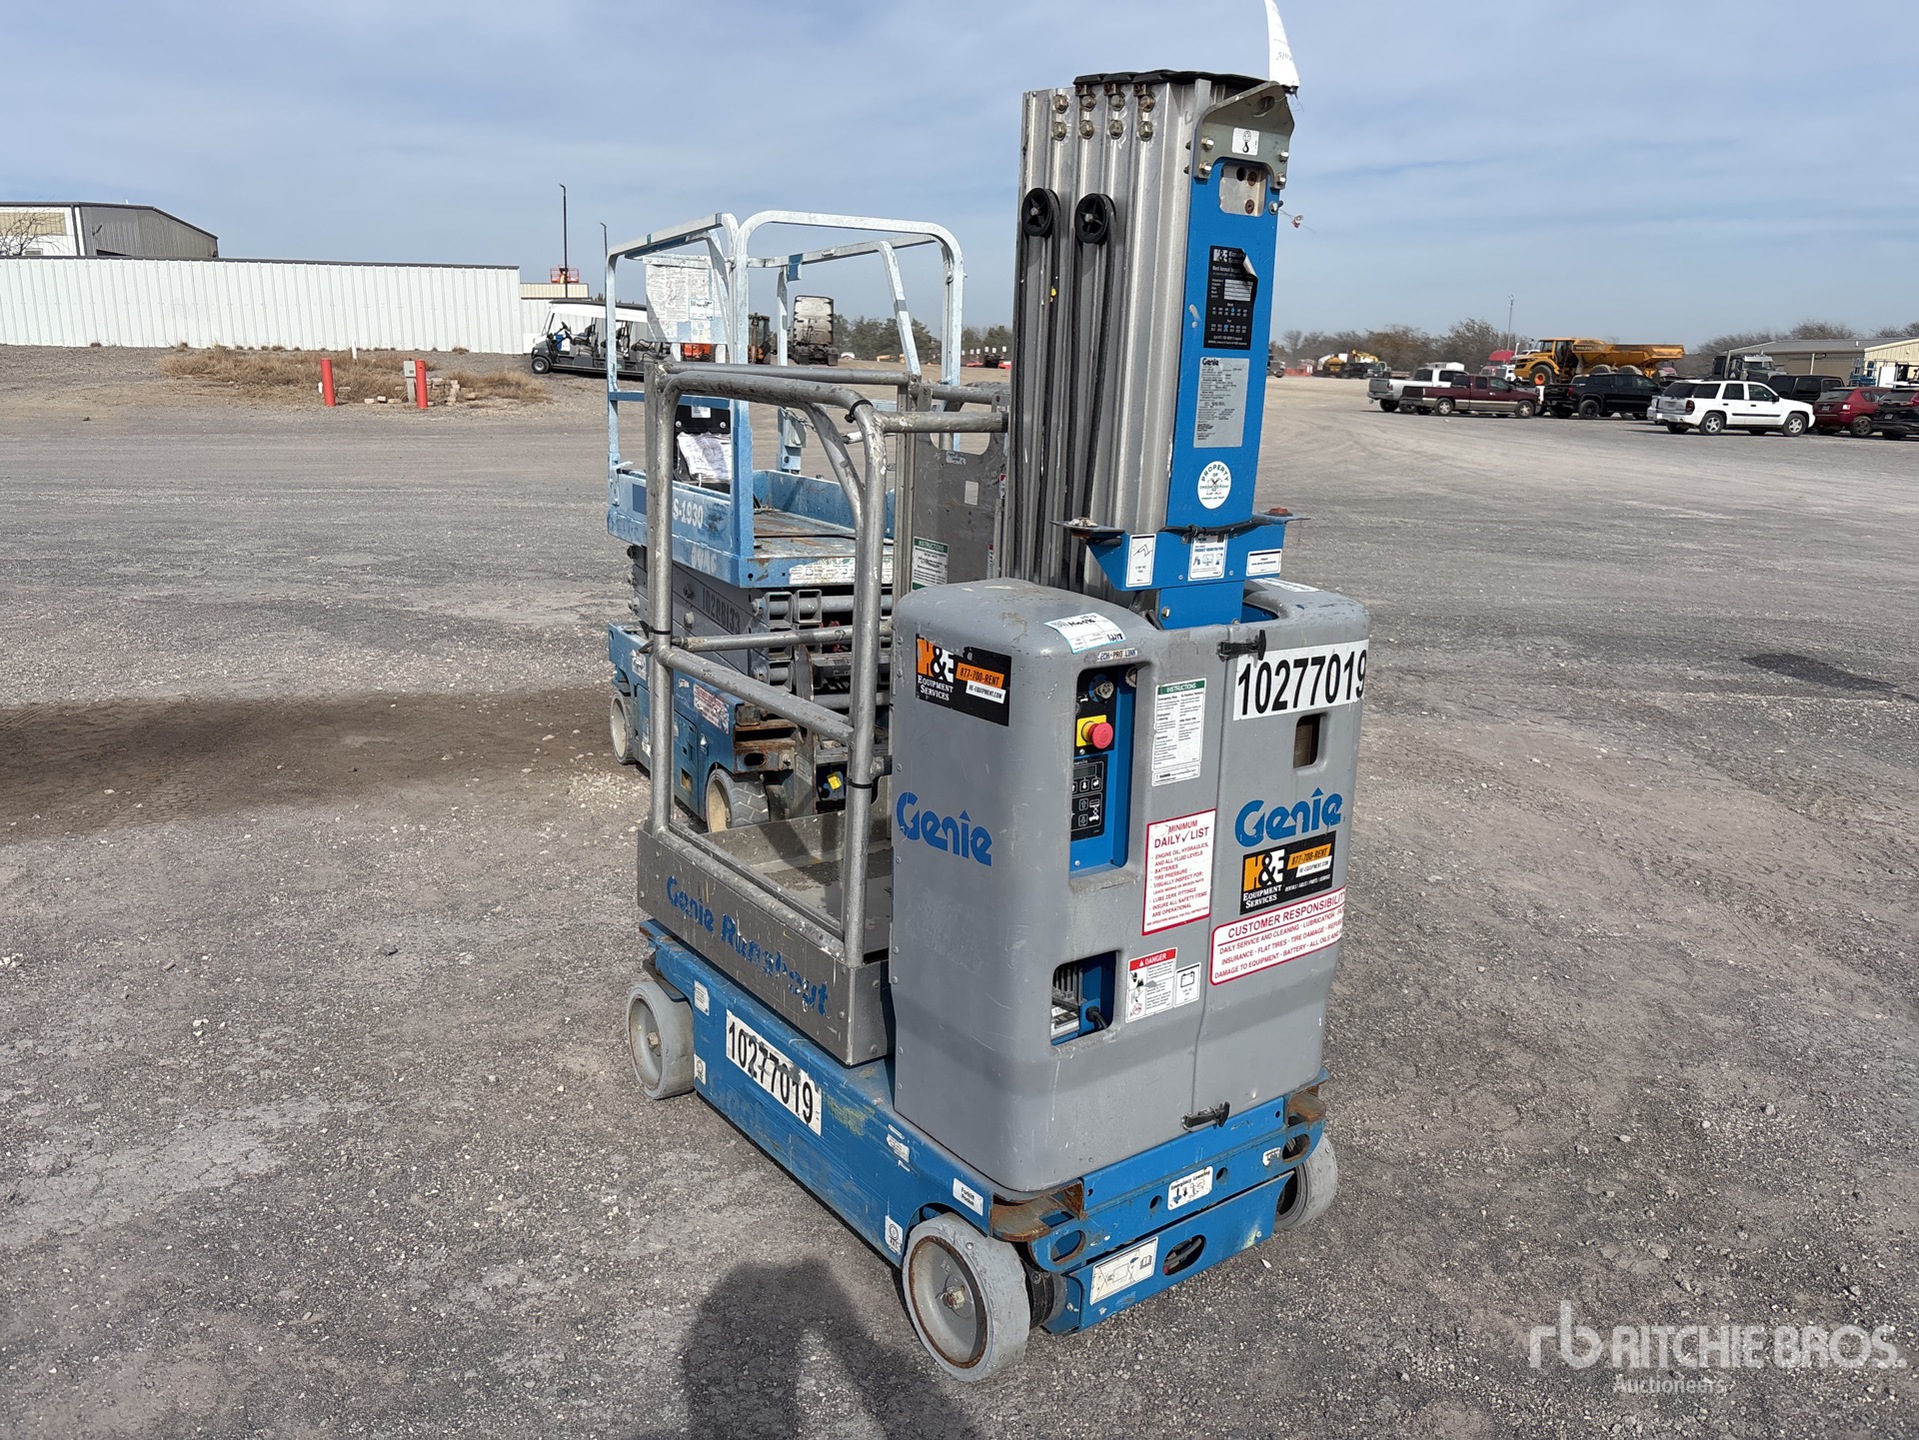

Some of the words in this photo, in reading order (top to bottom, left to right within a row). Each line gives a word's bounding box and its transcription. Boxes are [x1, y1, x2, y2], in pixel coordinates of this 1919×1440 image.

[1202, 358, 1219, 366] Genie
[1201, 464, 1229, 481] PROPERTY
[917, 638, 954, 683] H&E
[918, 675, 953, 693] EQUIPMENT
[960, 667, 1000, 687] 877-700-RENT
[1238, 649, 1367, 715] 10277019
[920, 685, 949, 701] SERVICES
[1168, 820, 1198, 832] MINIMUM
[1235, 787, 1343, 847] Genie
[896, 791, 993, 867] Genie
[1154, 833, 1181, 848] DAILY
[1191, 826, 1210, 840] LIST
[1291, 848, 1328, 865] 877-700-RENT
[1155, 864, 1178, 874] BATTERIES
[1165, 868, 1188, 878] PRESSURE
[1243, 849, 1285, 892] H&E
[666, 875, 714, 933] Genie
[1243, 885, 1282, 902] EQUIPMENT
[1245, 894, 1277, 909] SERVICES
[1228, 914, 1280, 938] CUSTOMER
[1283, 891, 1345, 921] RESPONSIBILIT
[1219, 944, 1236, 954] DAILY
[1237, 936, 1260, 949] SERVICE
[1260, 933, 1272, 941] AND
[1273, 924, 1299, 938] CLEANING
[1221, 950, 1254, 965] INSURANCE
[1257, 944, 1271, 953] FLAT
[1272, 939, 1287, 949] TIRES
[1291, 934, 1302, 942] TIRE
[1303, 926, 1324, 939] DAMAGE
[1144, 953, 1167, 965] DANGER
[1215, 965, 1239, 979] DAMAGE
[1249, 952, 1280, 968] EQUIPMENT
[1283, 943, 1307, 956] BATTERY
[729, 1022, 813, 1124] 10277019
